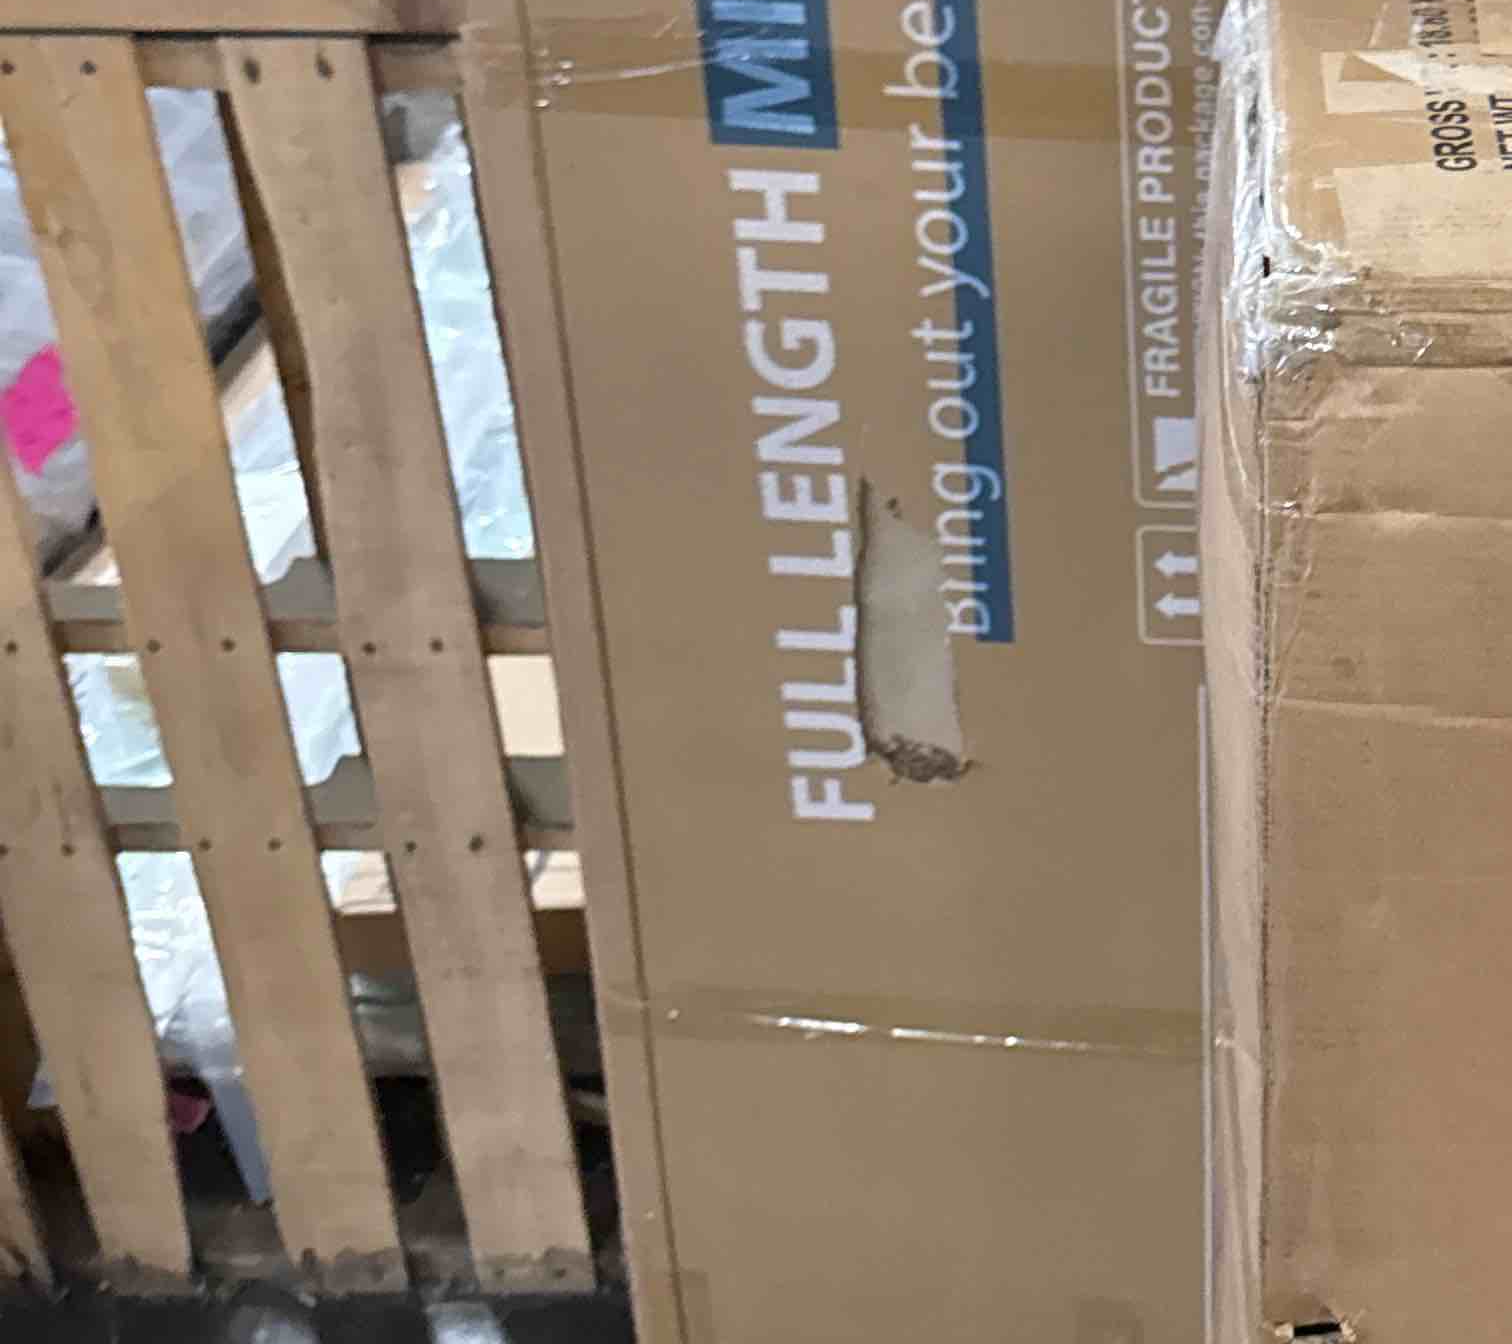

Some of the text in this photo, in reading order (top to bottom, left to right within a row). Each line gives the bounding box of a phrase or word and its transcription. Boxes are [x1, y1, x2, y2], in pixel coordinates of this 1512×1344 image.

[892, 124, 990, 299] your
[1427, 100, 1476, 172] GROSS
[728, 168, 851, 575] LENGTH
[908, 321, 974, 438] out
[1138, 216, 1181, 397] FRAGILE
[775, 604, 874, 821] FULL
